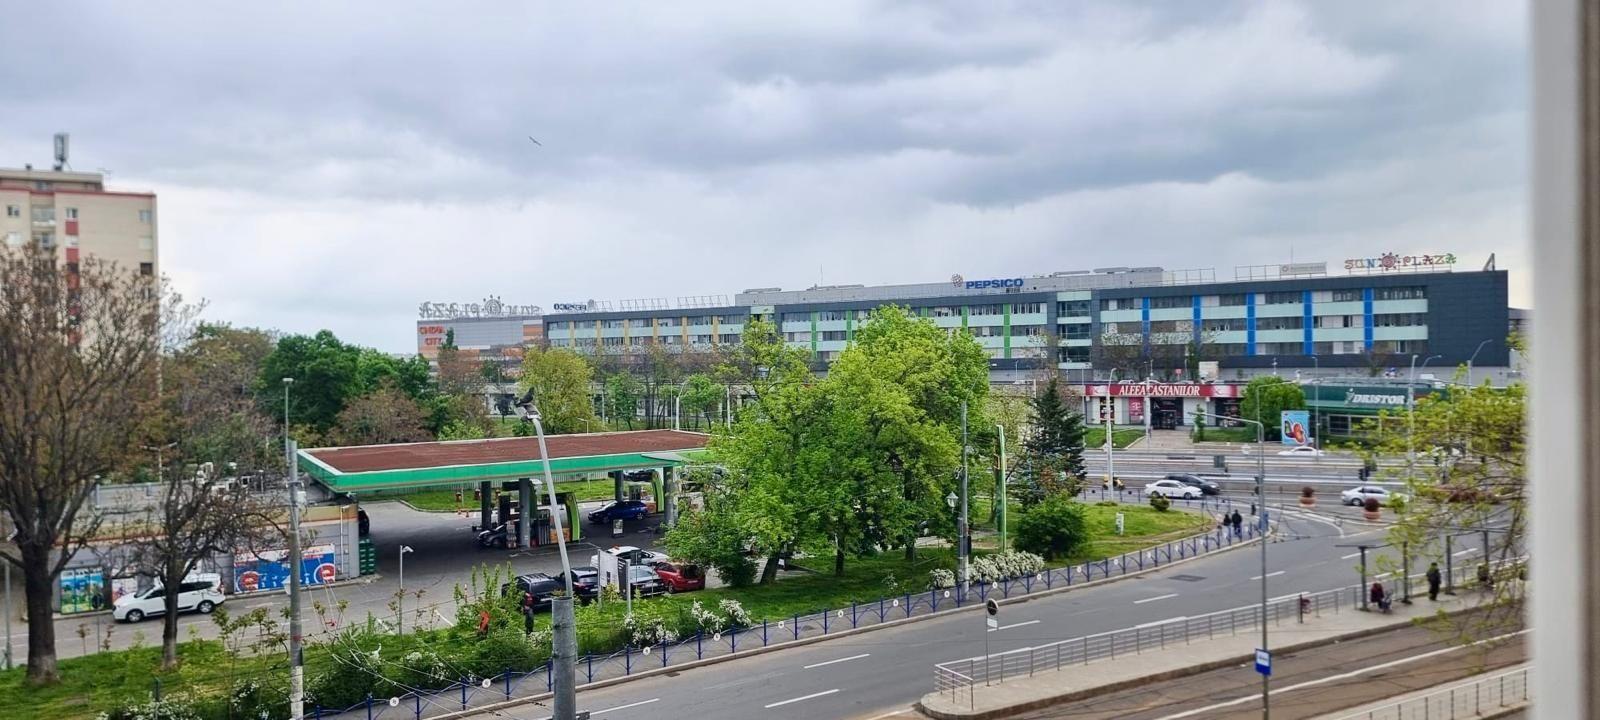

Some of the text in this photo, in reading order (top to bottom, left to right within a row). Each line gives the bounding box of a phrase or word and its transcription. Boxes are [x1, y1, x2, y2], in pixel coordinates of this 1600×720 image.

[1402, 253, 1457, 267] PLAZA
[965, 278, 1024, 289] PEPSICO
[1119, 385, 1200, 396] ALEEA CASTANILOR
[1352, 394, 1405, 404] DRISTOR
